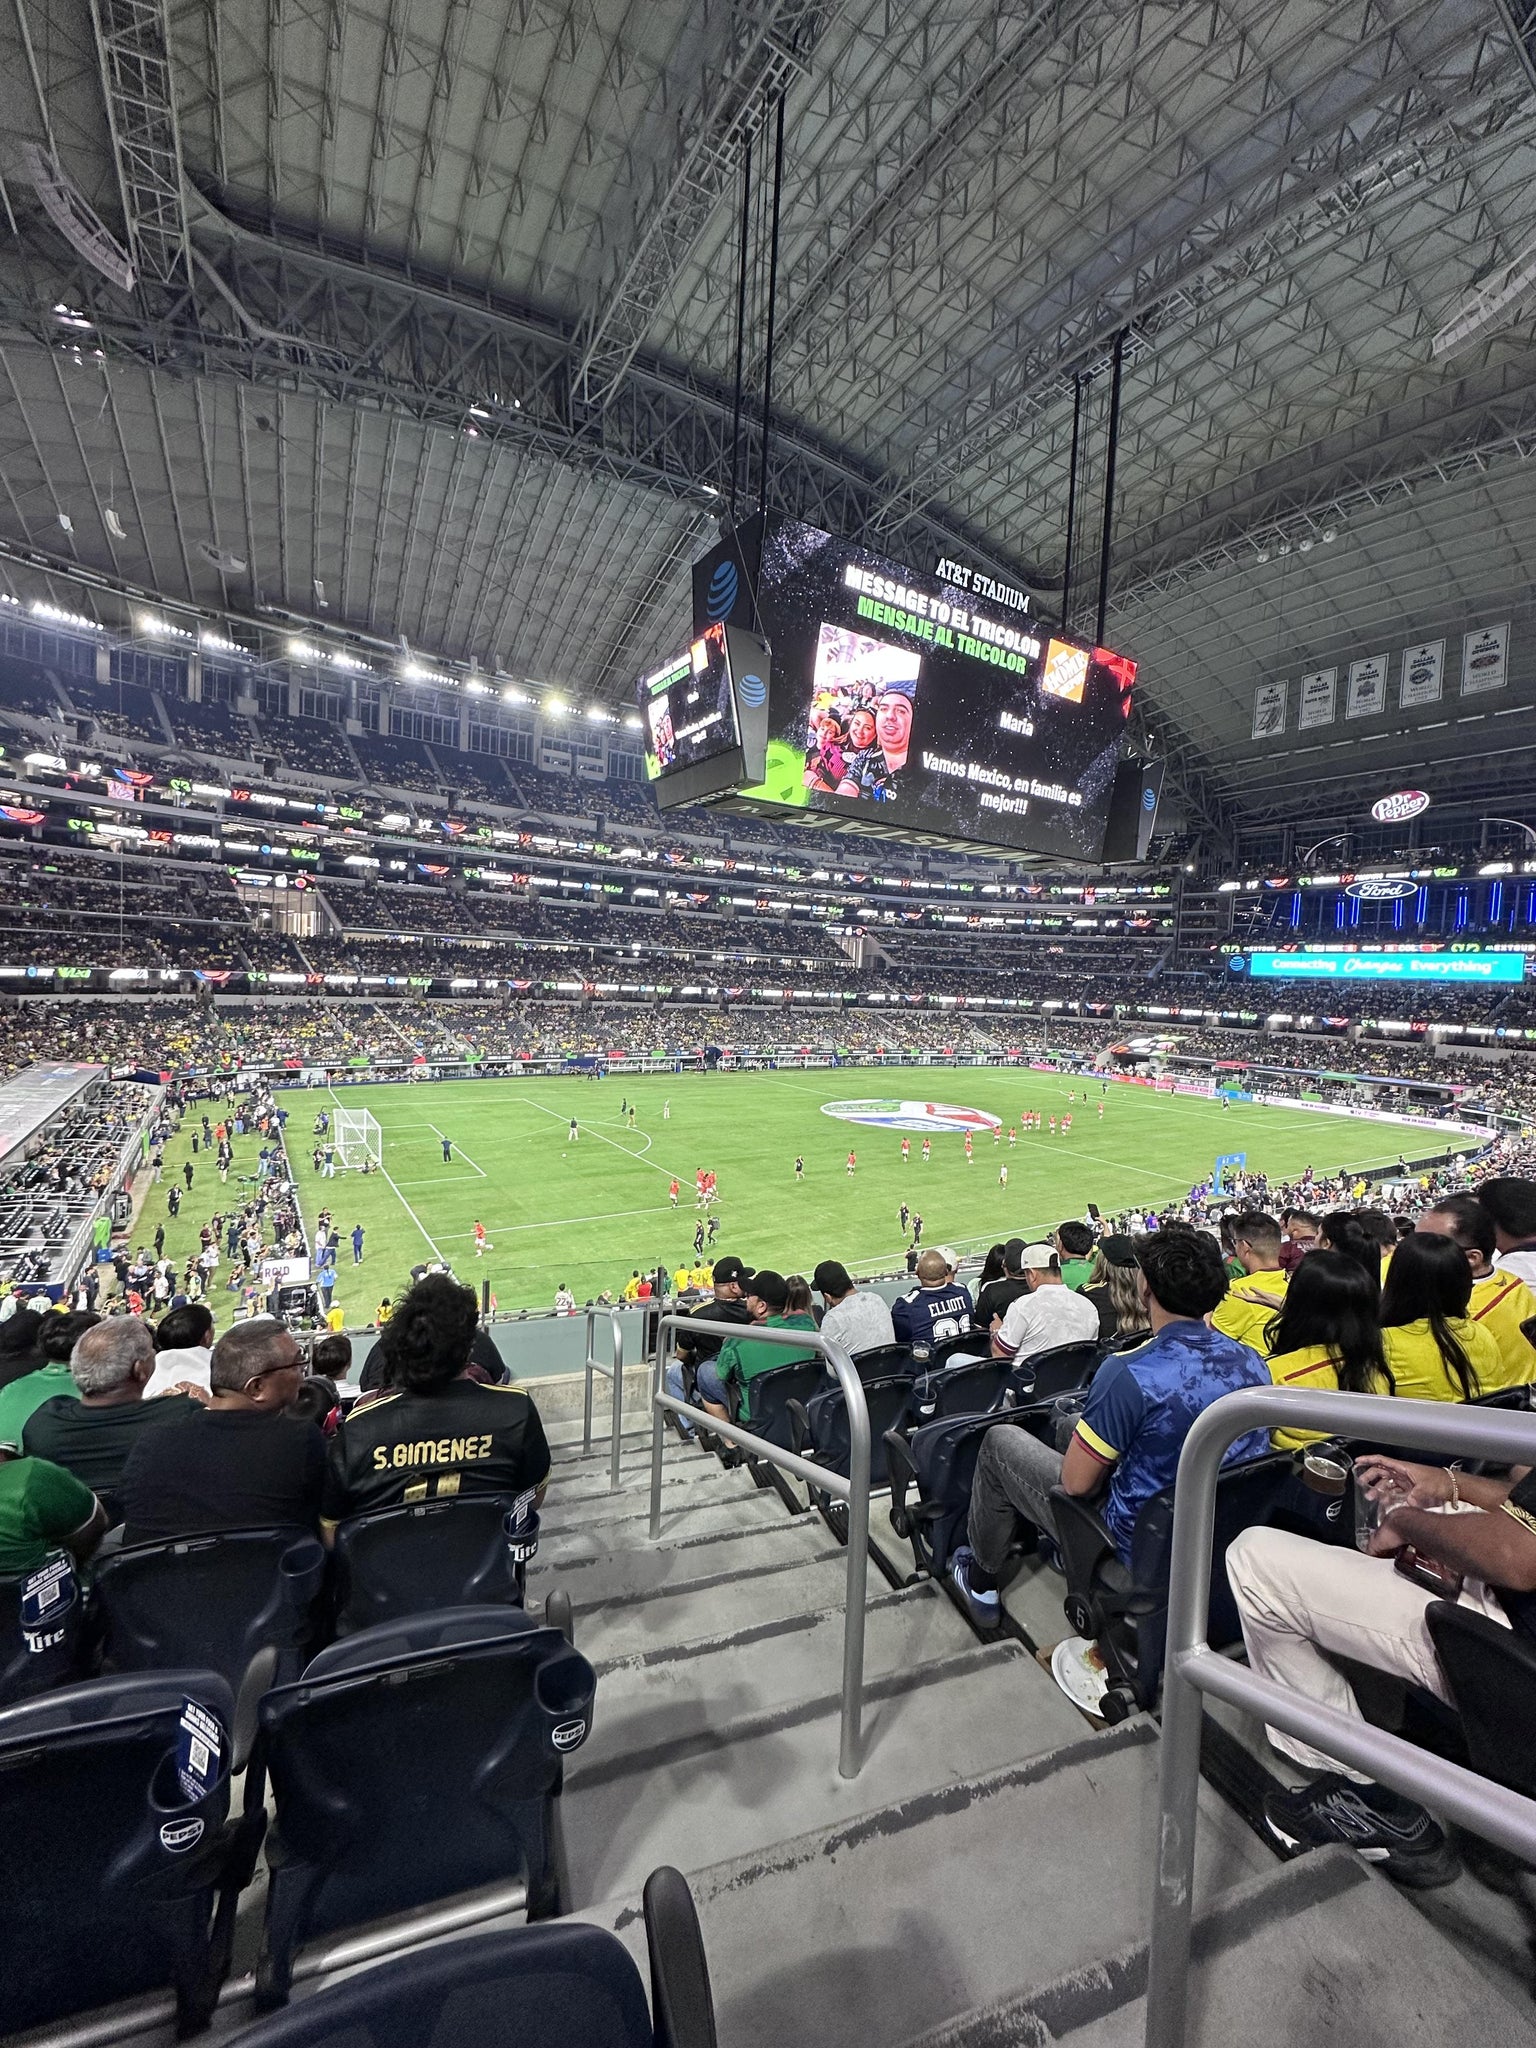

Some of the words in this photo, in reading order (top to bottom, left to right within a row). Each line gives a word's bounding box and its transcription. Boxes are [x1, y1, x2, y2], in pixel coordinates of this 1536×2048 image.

[935, 557, 972, 588] AT&T
[973, 573, 1030, 614] STADIUM
[844, 564, 928, 614] MESSAGE
[930, 599, 950, 623] TO
[951, 607, 970, 632] EL
[972, 616, 1041, 659] TRICOLOR
[857, 595, 934, 641] MENSAJE
[934, 626, 955, 649] AL
[957, 633, 1027, 674] TRICOLOR
[1474, 640, 1497, 649] DALLAS
[80, 762, 101, 775] VS
[922, 751, 966, 778] Vamos
[968, 763, 1013, 791] Mexico,
[1014, 778, 1030, 793] en
[1030, 779, 1068, 801] familia
[1069, 792, 1083, 806] es
[232, 789, 250, 800] VS
[1390, 794, 1412, 807] Dr
[981, 792, 1028, 816] mejor!!!
[1378, 797, 1425, 820] Pepper
[151, 831, 172, 842] VS
[1340, 874, 1354, 884] VS
[1358, 882, 1403, 897] Ford
[1272, 958, 1336, 972] Connecting
[1410, 960, 1493, 975] Everything
[1412, 1021, 1427, 1032] VS
[928, 1296, 967, 1318] ELLIOTT
[373, 1434, 493, 1470] S.GIMENEZ
[23, 1627, 65, 1652] Lite
[554, 1724, 584, 1741] PEPSI
[162, 1824, 202, 1841] PEPSI
